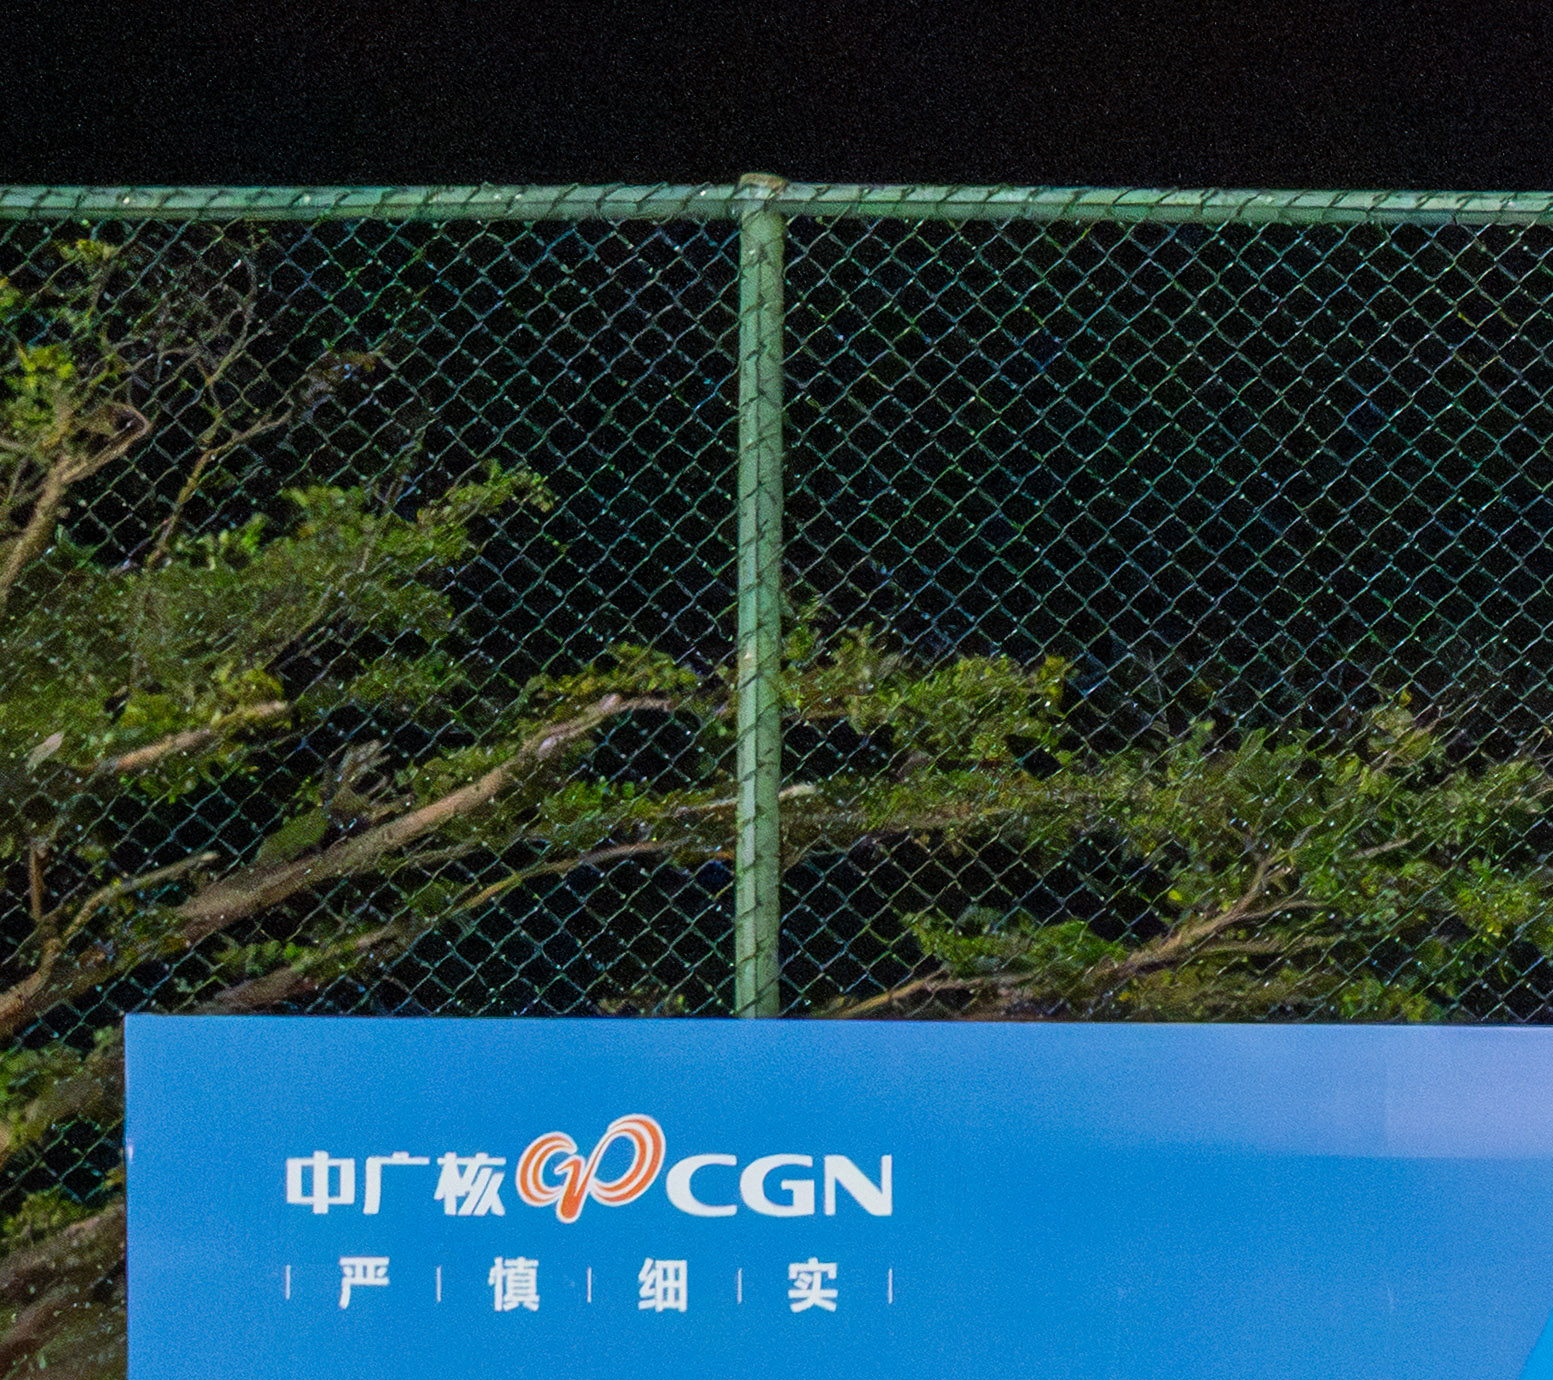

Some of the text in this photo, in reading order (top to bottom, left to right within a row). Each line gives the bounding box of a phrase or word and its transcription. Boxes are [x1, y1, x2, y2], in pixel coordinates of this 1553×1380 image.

[286, 1152, 893, 1217] 中广核 CGN
[339, 1256, 839, 1312] 严 慎 细 实
